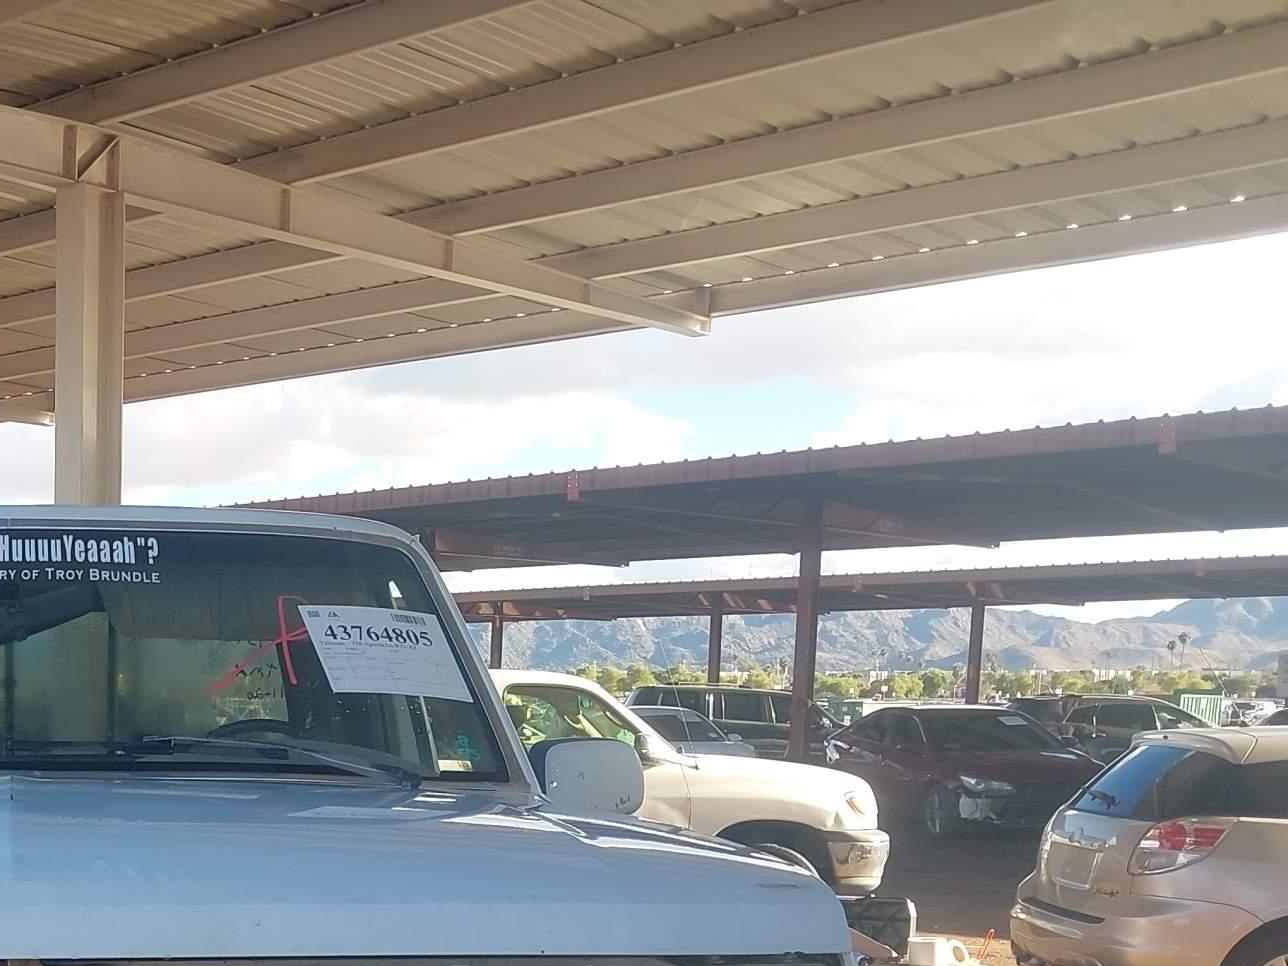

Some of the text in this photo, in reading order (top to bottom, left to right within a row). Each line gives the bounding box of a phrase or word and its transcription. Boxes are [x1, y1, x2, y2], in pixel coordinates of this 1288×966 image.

[45, 567, 84, 580] TROY
[89, 568, 161, 583] BRUNDLE
[324, 624, 433, 647] 43764805
